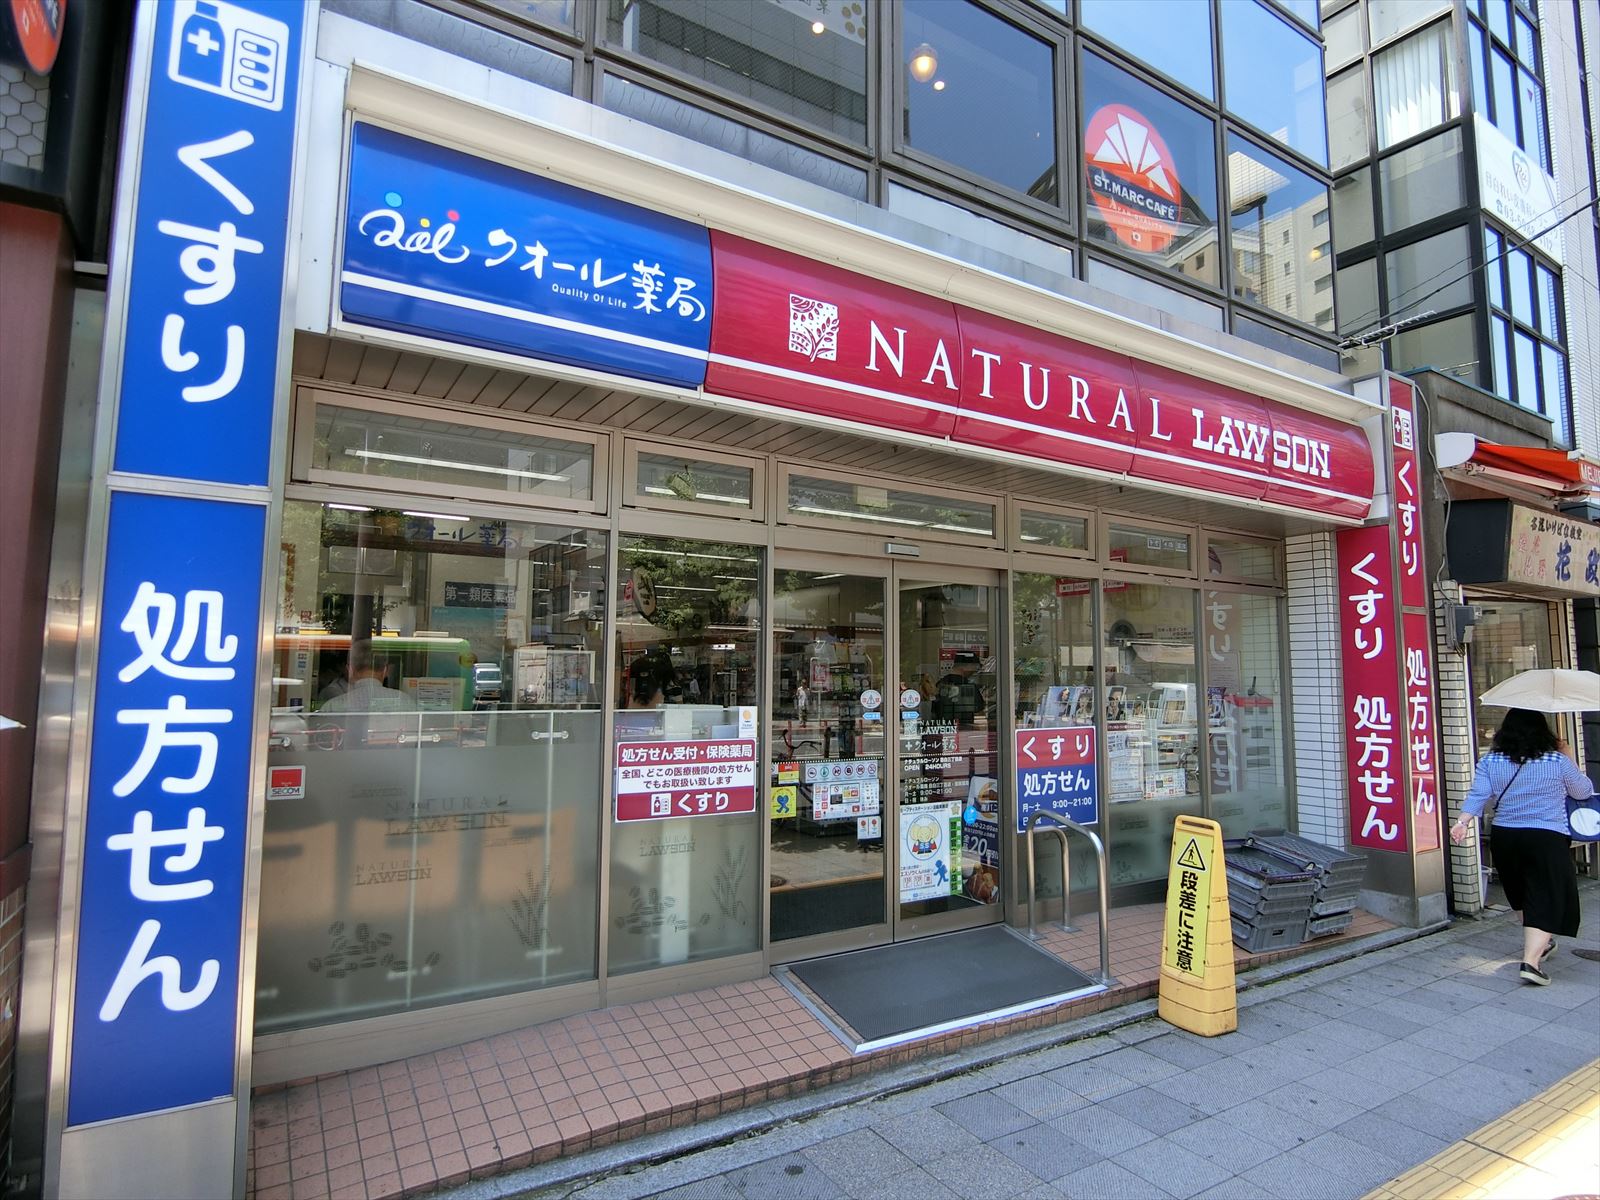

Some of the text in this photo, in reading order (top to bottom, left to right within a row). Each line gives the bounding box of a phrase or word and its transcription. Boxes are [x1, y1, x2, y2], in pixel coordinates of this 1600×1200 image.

[1094, 174, 1145, 206] ST.MARC
[1145, 198, 1175, 220] CAFÉ
[158, 130, 264, 403] くすり
[485, 229, 706, 322] クオール薬局
[552, 283, 627, 309] Quality Of Life
[865, 320, 1331, 479] NATURAL LAWSON
[1398, 460, 1418, 576] くすり
[1349, 552, 1398, 840] くすり 処方せん
[920, 725, 957, 735] LAWSON
[1407, 648, 1434, 816] 処方せん
[622, 744, 752, 763] 処方せん受付・保険薬局
[1023, 734, 1089, 761] くすり
[622, 764, 752, 779] 全国、どこの医療機関の処方せん
[643, 776, 733, 789] でもお取扱い致します
[1023, 769, 1090, 797] 処方せん
[100, 581, 239, 1022] 処方せん
[272, 787, 300, 795] SECOM
[677, 791, 729, 813] くすり
[354, 868, 433, 886] LAWSON
[1176, 871, 1199, 971] 段差に注意
